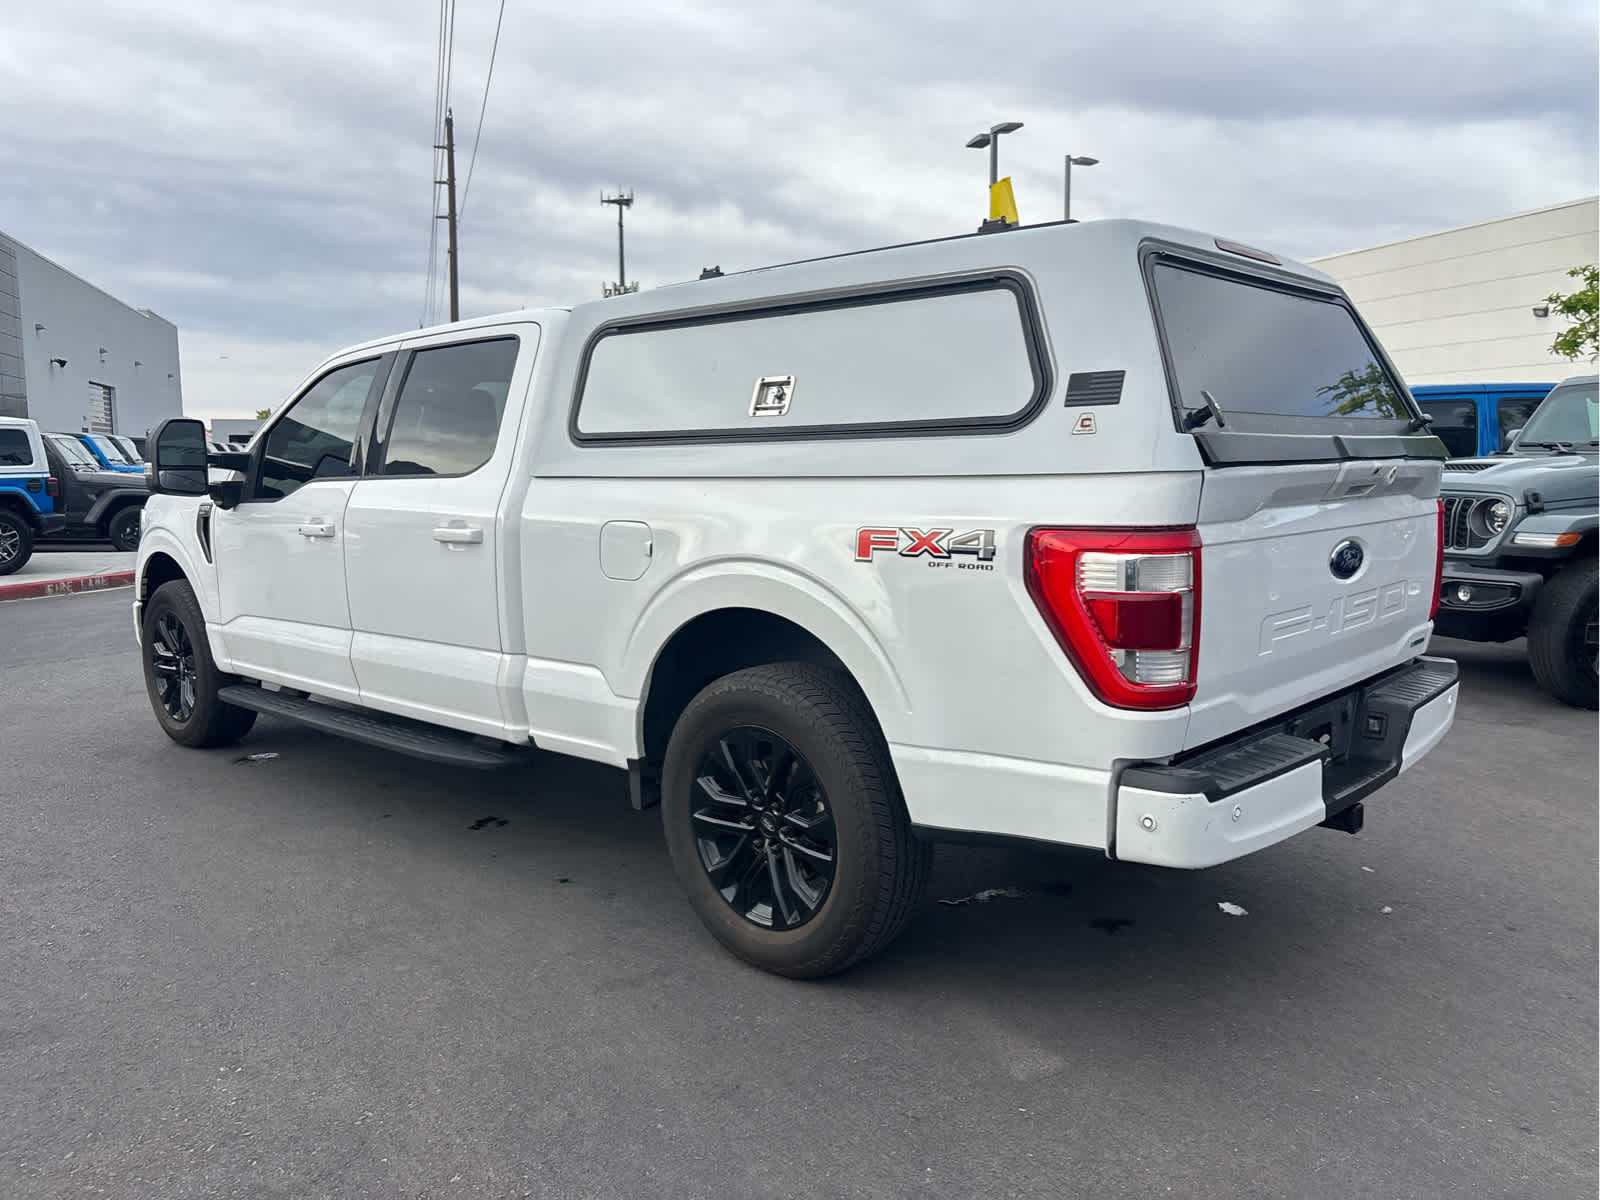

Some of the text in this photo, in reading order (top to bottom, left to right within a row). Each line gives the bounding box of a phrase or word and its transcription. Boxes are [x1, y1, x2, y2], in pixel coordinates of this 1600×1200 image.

[854, 526, 997, 562] FX4
[928, 561, 994, 571] OFF ROAD
[1258, 579, 1409, 656] F-150
